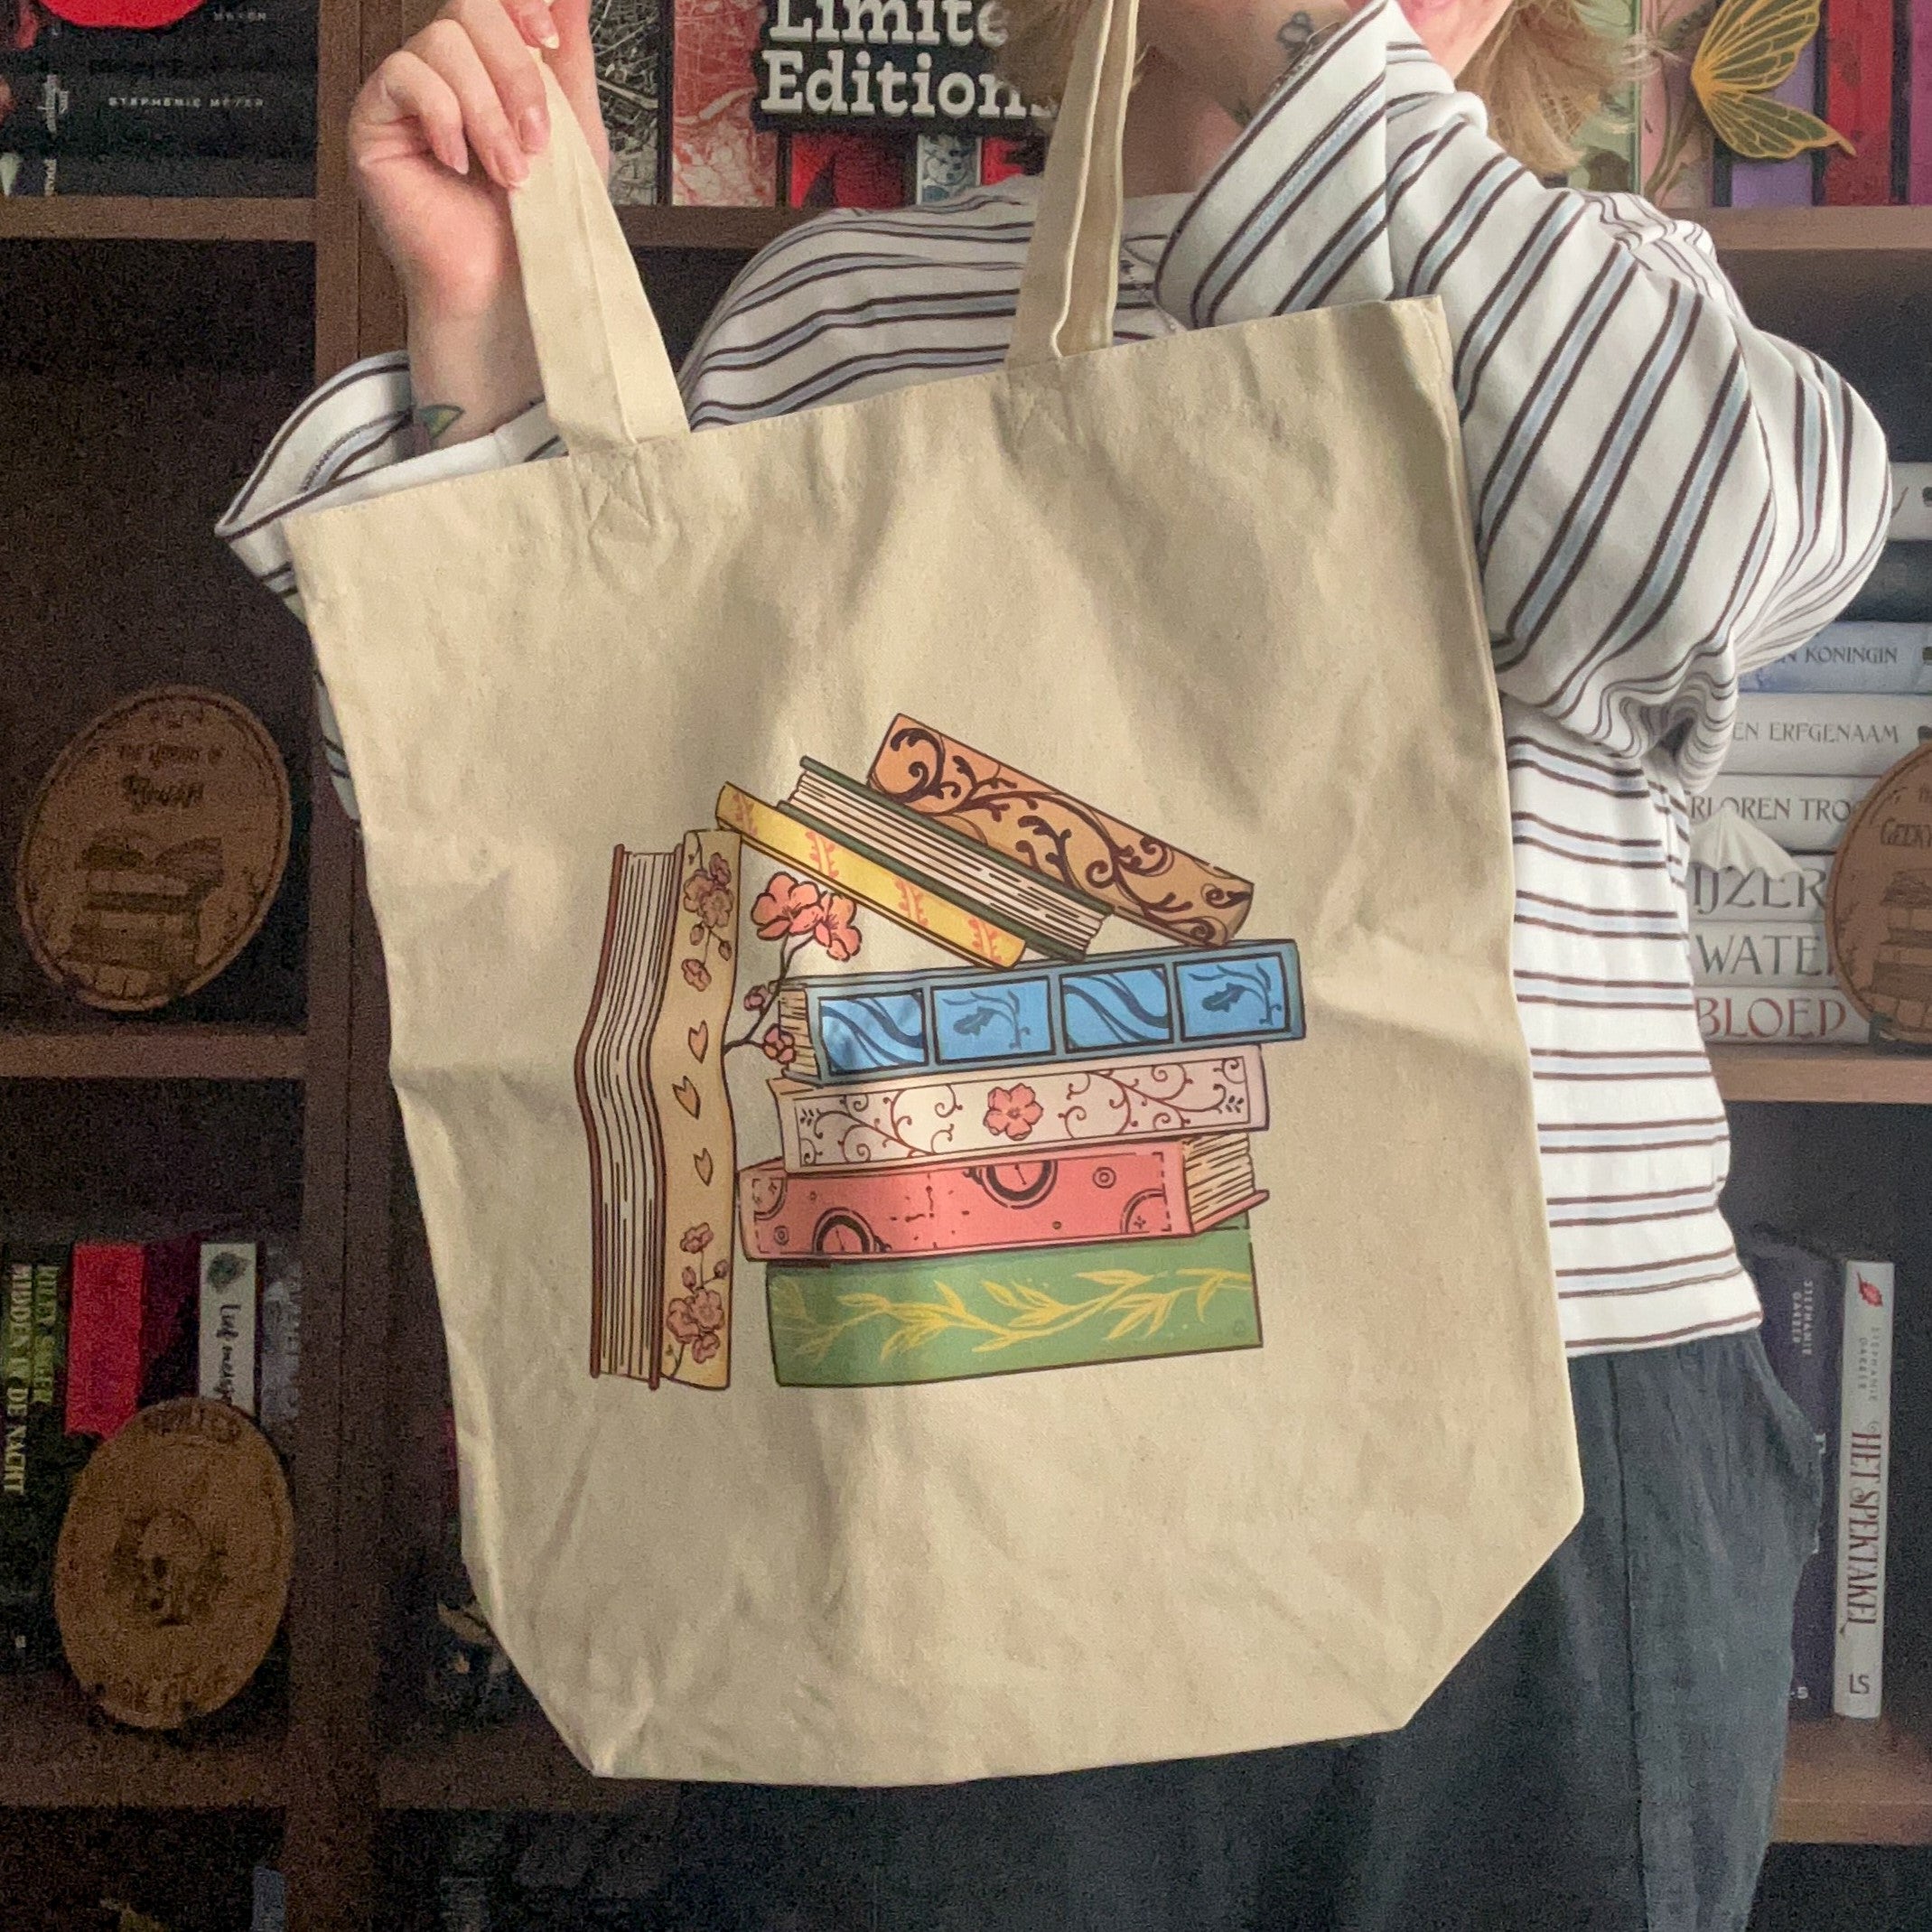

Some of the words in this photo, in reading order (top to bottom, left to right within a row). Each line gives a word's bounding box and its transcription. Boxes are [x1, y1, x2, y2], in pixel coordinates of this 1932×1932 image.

[769, 0, 1009, 46] Limite
[761, 50, 1059, 119] Edition
[1805, 646, 1899, 665] KONINGIN
[1732, 722, 1759, 741] EN
[1769, 723, 1899, 743] ERFGENAAM
[1690, 796, 1790, 822] RLOREN
[1799, 798, 1853, 824] TRO
[1695, 934, 1835, 975] WATE
[1694, 996, 1848, 1039] BLOED
[6, 1387, 29, 1417] DE
[5, 1424, 27, 1497] NACHT
[1850, 1423, 1882, 1483] HET
[1846, 1487, 1881, 1627] SPEKTAKEL
[1848, 1673, 1871, 1694] LS
